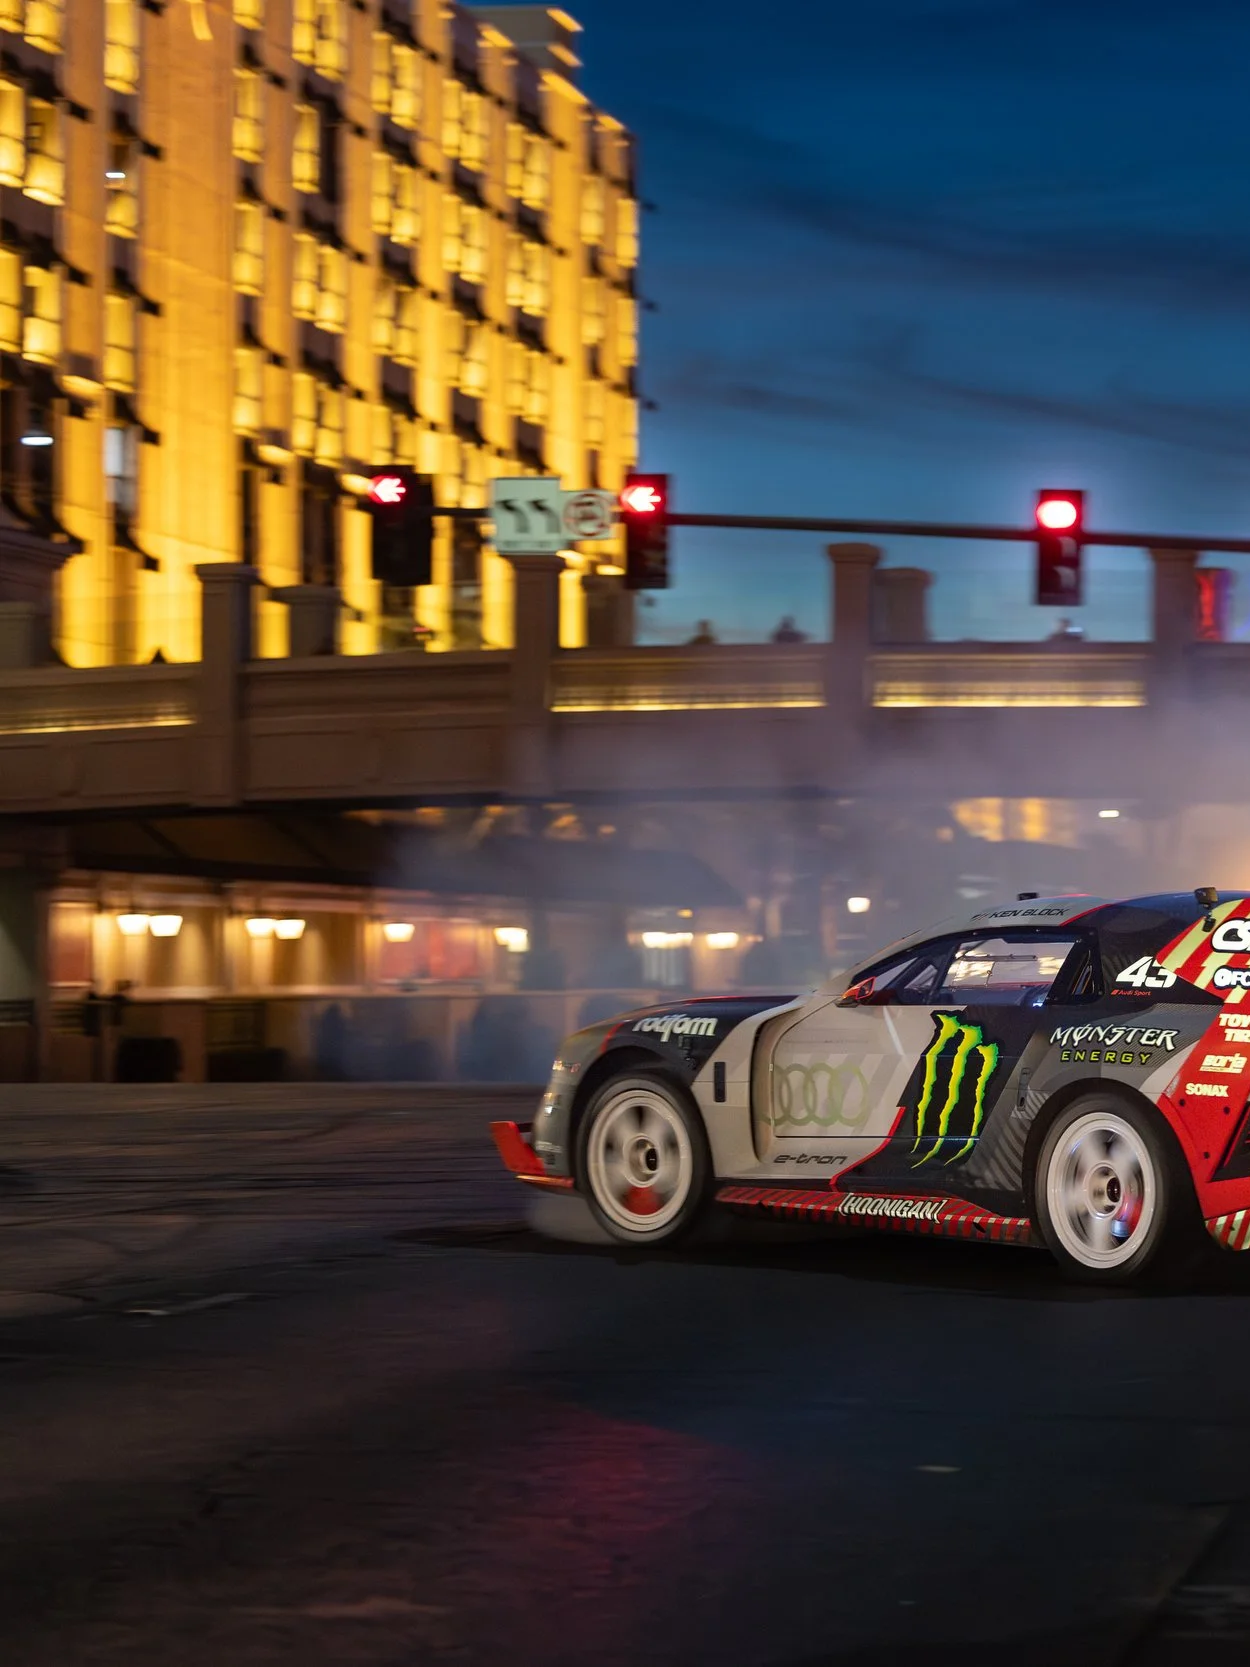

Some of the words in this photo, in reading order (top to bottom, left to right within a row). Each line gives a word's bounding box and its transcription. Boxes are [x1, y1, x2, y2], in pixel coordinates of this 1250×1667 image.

[989, 909, 1022, 919] KEN
[1021, 908, 1070, 917] BLOCK
[1116, 956, 1177, 988] 43
[1061, 1051, 1151, 1063] ENERGY
[1185, 1083, 1229, 1097] SONAX
[773, 1153, 848, 1165] e-tron
